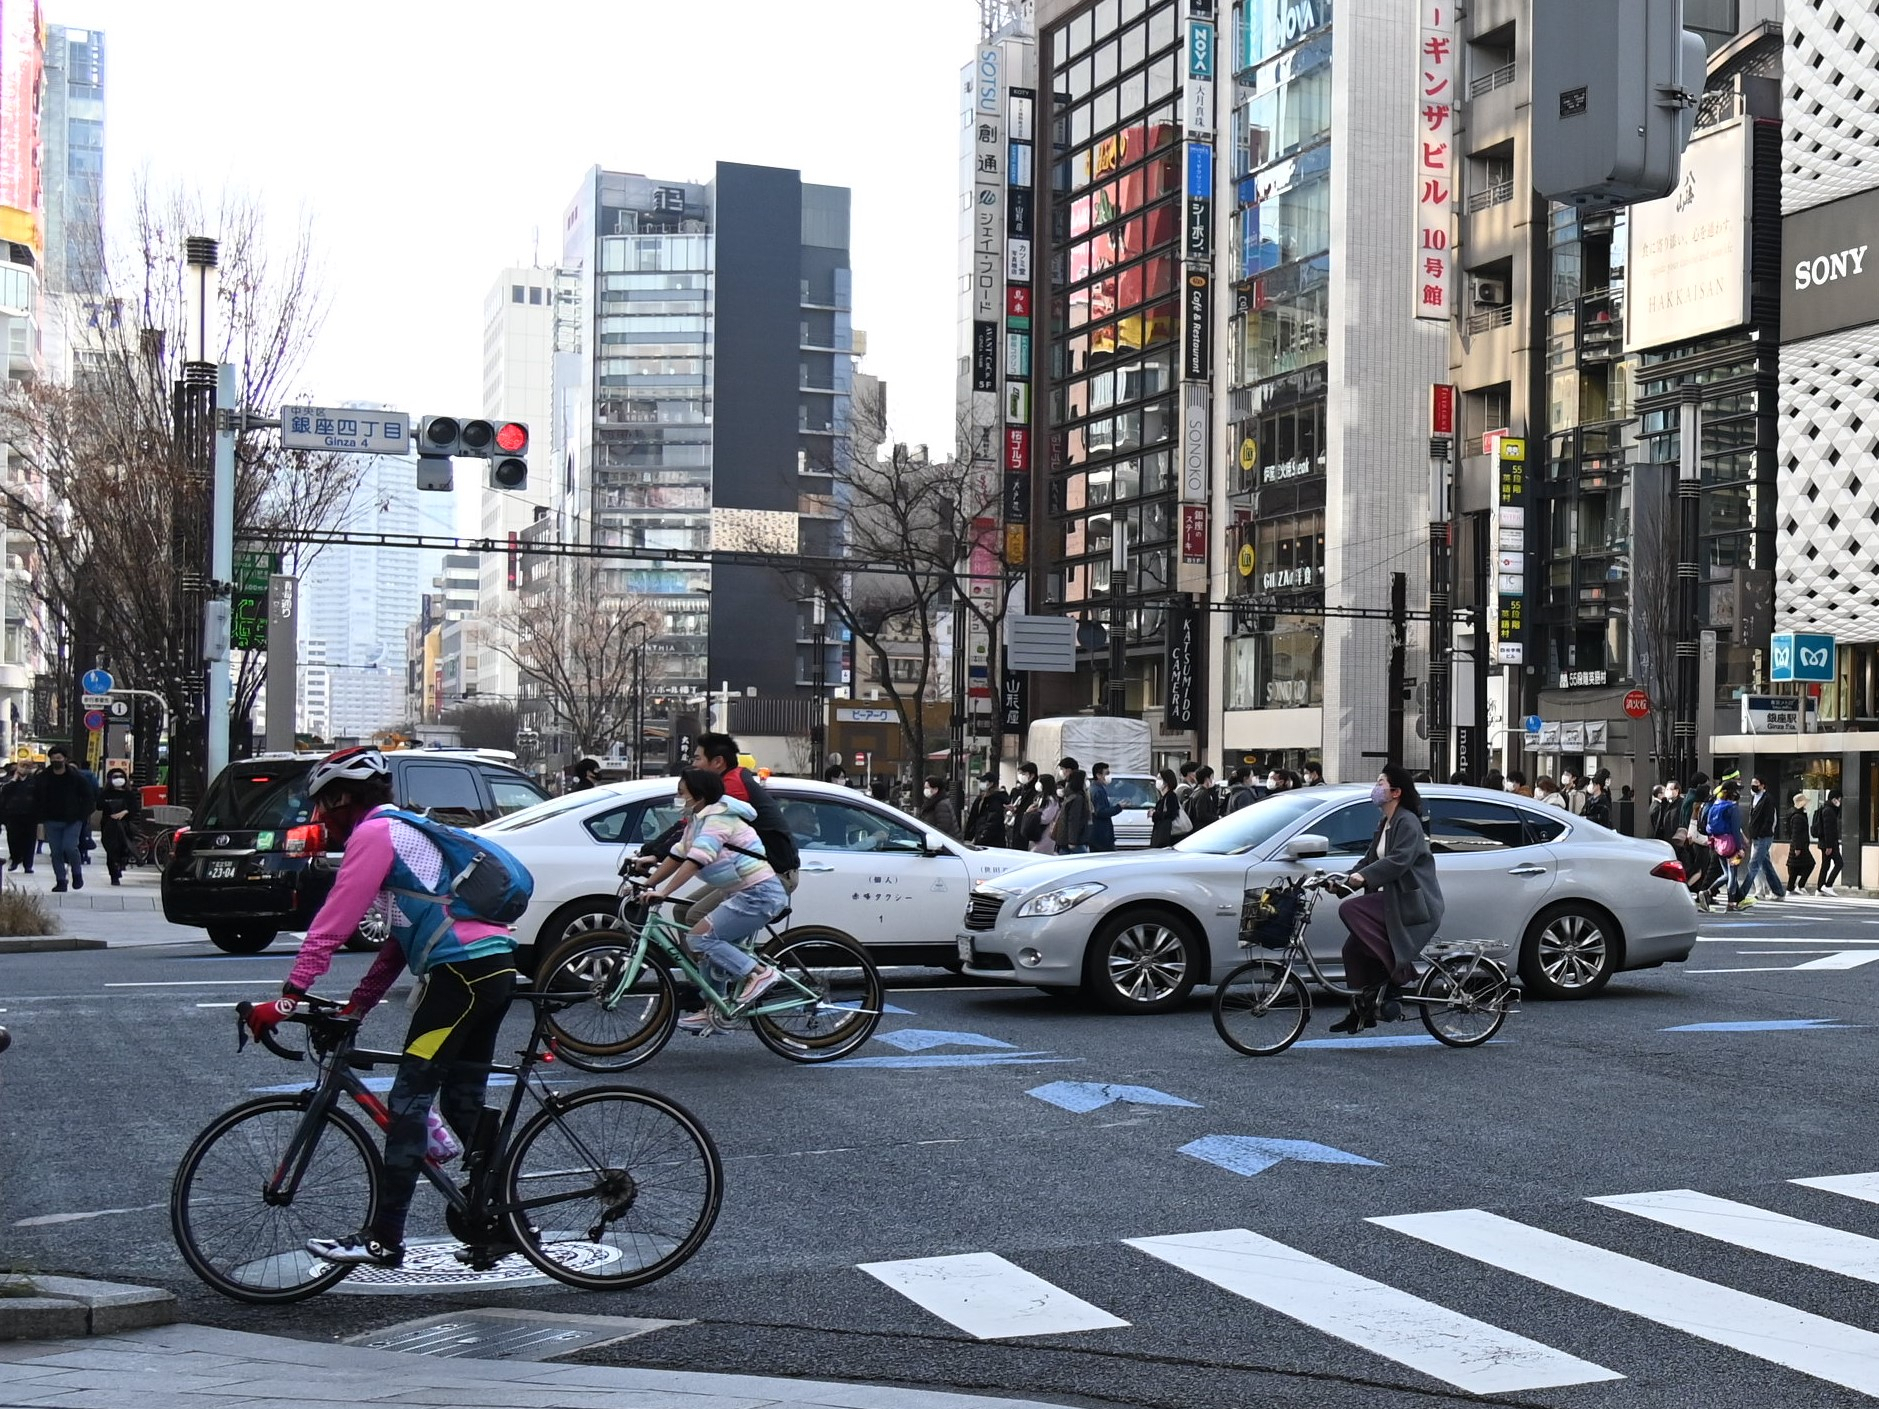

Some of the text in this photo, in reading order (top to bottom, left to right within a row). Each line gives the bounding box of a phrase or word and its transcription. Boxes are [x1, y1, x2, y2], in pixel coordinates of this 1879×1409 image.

[1194, 28, 1207, 71] NOVA
[981, 50, 997, 111] SOTSU
[978, 123, 998, 174] 創通
[1795, 245, 1868, 290] SONY
[1648, 277, 1724, 313] HAKKAISAN
[1192, 323, 1202, 373] Restaurant
[291, 407, 326, 417] 中央区
[291, 416, 401, 439] 銀座四丁目
[325, 436, 368, 448] Ginza 4
[1189, 421, 1202, 490] SONOKO
[1195, 510, 1204, 537] 銀座の
[1172, 648, 1181, 717] CAMERA
[1182, 619, 1192, 722] KATSUMIDO
[1006, 679, 1021, 724] 山形屋
[1767, 713, 1797, 723] 銀座駅
